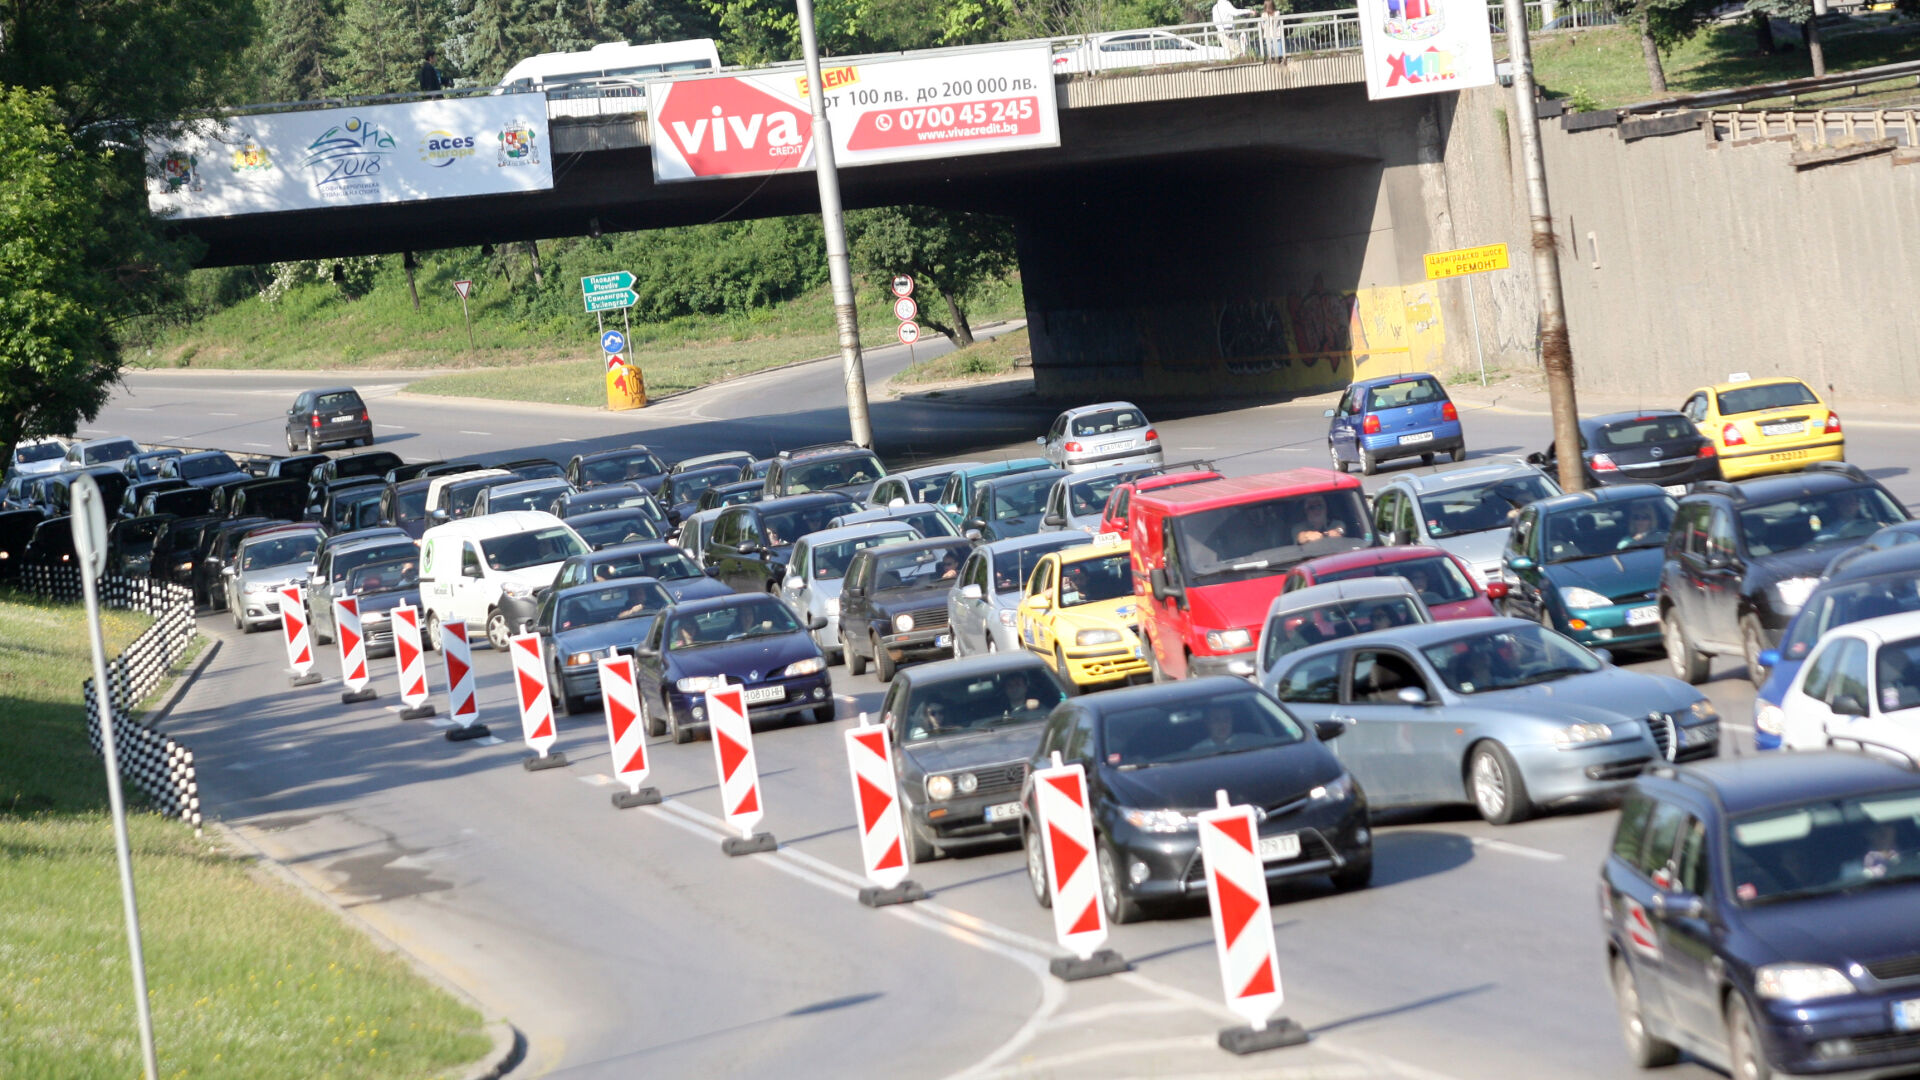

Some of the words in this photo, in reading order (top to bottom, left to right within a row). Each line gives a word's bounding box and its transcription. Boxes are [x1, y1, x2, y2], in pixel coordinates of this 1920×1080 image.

[800, 66, 855, 94] ЗЕМ
[849, 89, 879, 105] 100
[883, 90, 909, 104] лв.
[917, 86, 938, 103] до
[942, 80, 972, 97] 200
[977, 77, 1008, 94] 000
[1012, 78, 1037, 91] лв.
[900, 106, 955, 130] 0700
[959, 103, 987, 124] 45
[991, 99, 1033, 122] 245
[671, 105, 803, 154] viva
[917, 122, 1018, 141] www.vivacredit.bg
[428, 136, 475, 151] aces
[769, 145, 803, 156] CREDIT
[428, 147, 476, 159] europe
[316, 154, 384, 187] 2018
[1456, 259, 1497, 273] РЕМОНТ
[594, 282, 618, 291] Plovdiv
[591, 297, 628, 309] Svilengrad
[750, 688, 770, 699] 0810
